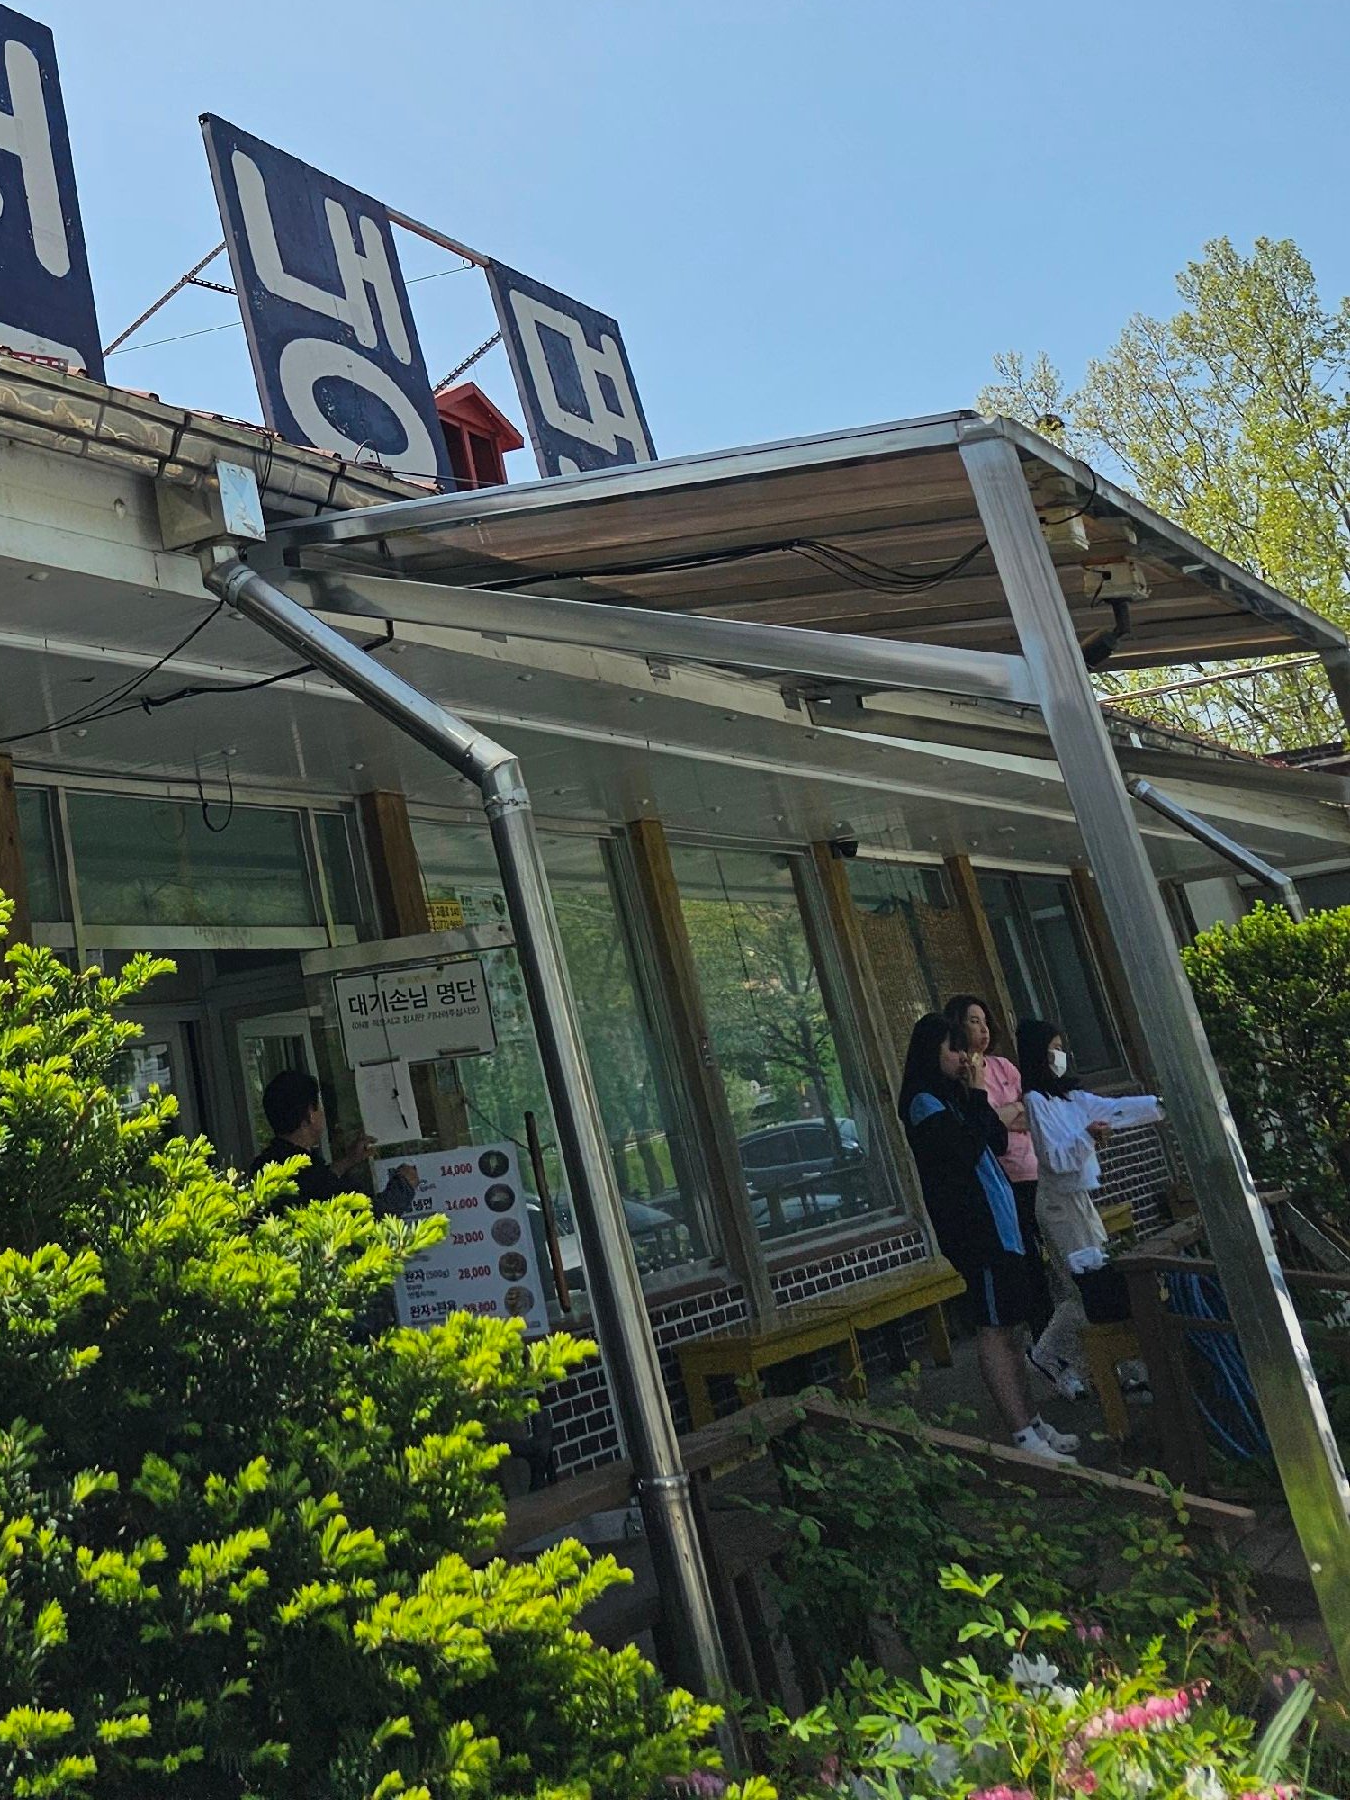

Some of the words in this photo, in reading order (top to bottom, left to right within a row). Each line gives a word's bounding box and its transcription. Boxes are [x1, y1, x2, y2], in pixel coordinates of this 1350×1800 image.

[347, 984, 429, 1016] 대기손님
[436, 978, 478, 1005] 명단
[457, 1264, 492, 1281] 28,000
